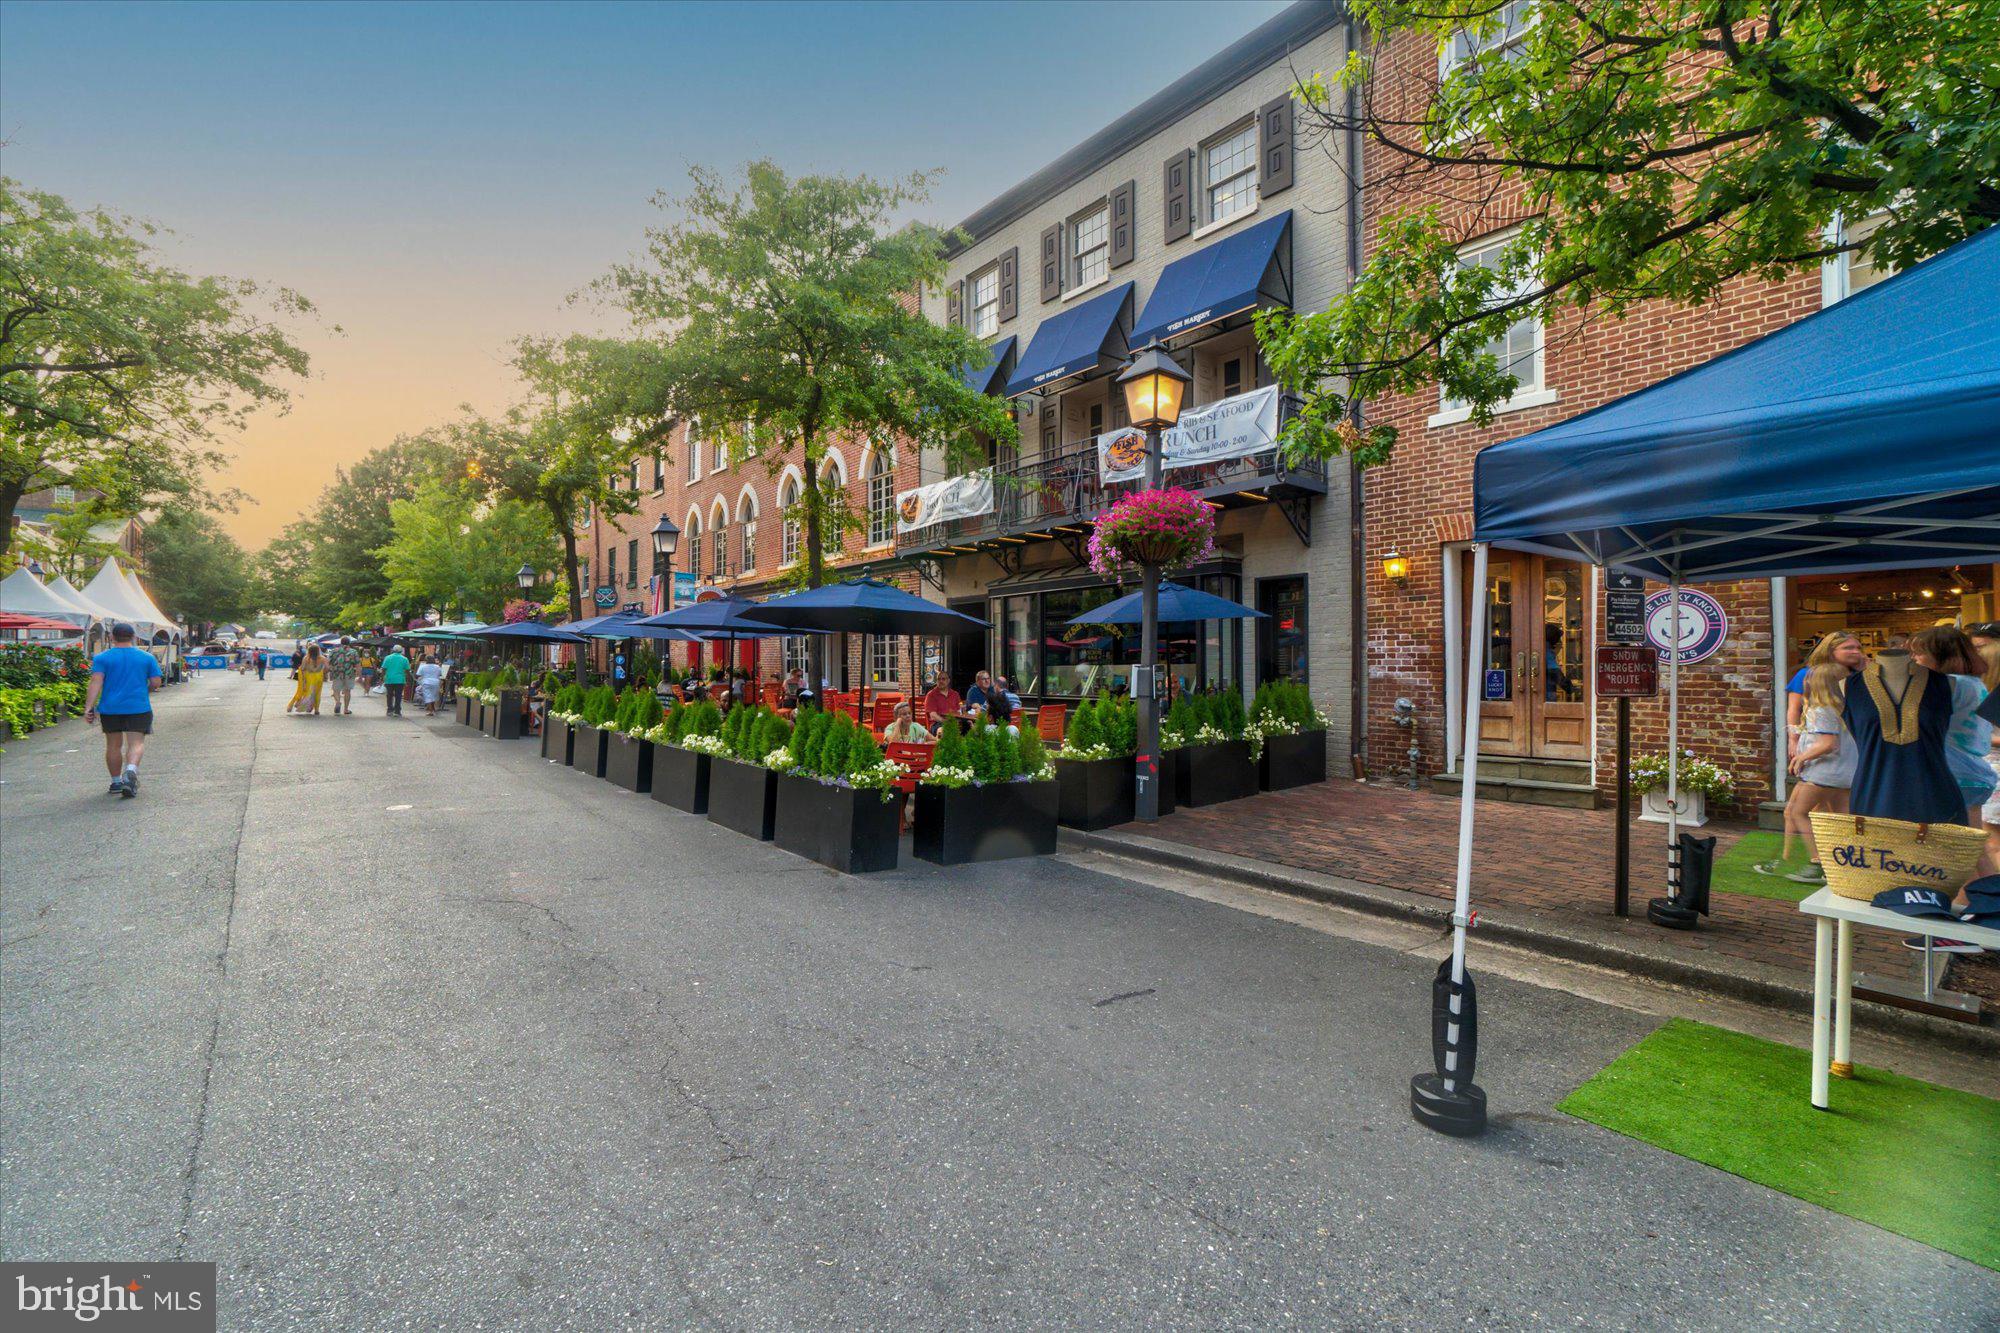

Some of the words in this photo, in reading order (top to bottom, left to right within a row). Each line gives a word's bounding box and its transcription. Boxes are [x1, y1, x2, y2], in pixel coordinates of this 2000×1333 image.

[1206, 401, 1254, 422] SEAFOOD
[1166, 424, 1217, 447] RUNCH
[1186, 443, 1211, 456] Sunday
[1616, 625, 1644, 634] 44502
[1612, 650, 1639, 661] SNOW
[1659, 649, 1698, 660] MN'S
[1598, 662, 1653, 673] EMERGENCY
[1610, 674, 1641, 685] ROUTE
[1833, 845, 1871, 869] Old
[1871, 849, 1948, 880] Town
[1904, 889, 1942, 907] ALX
